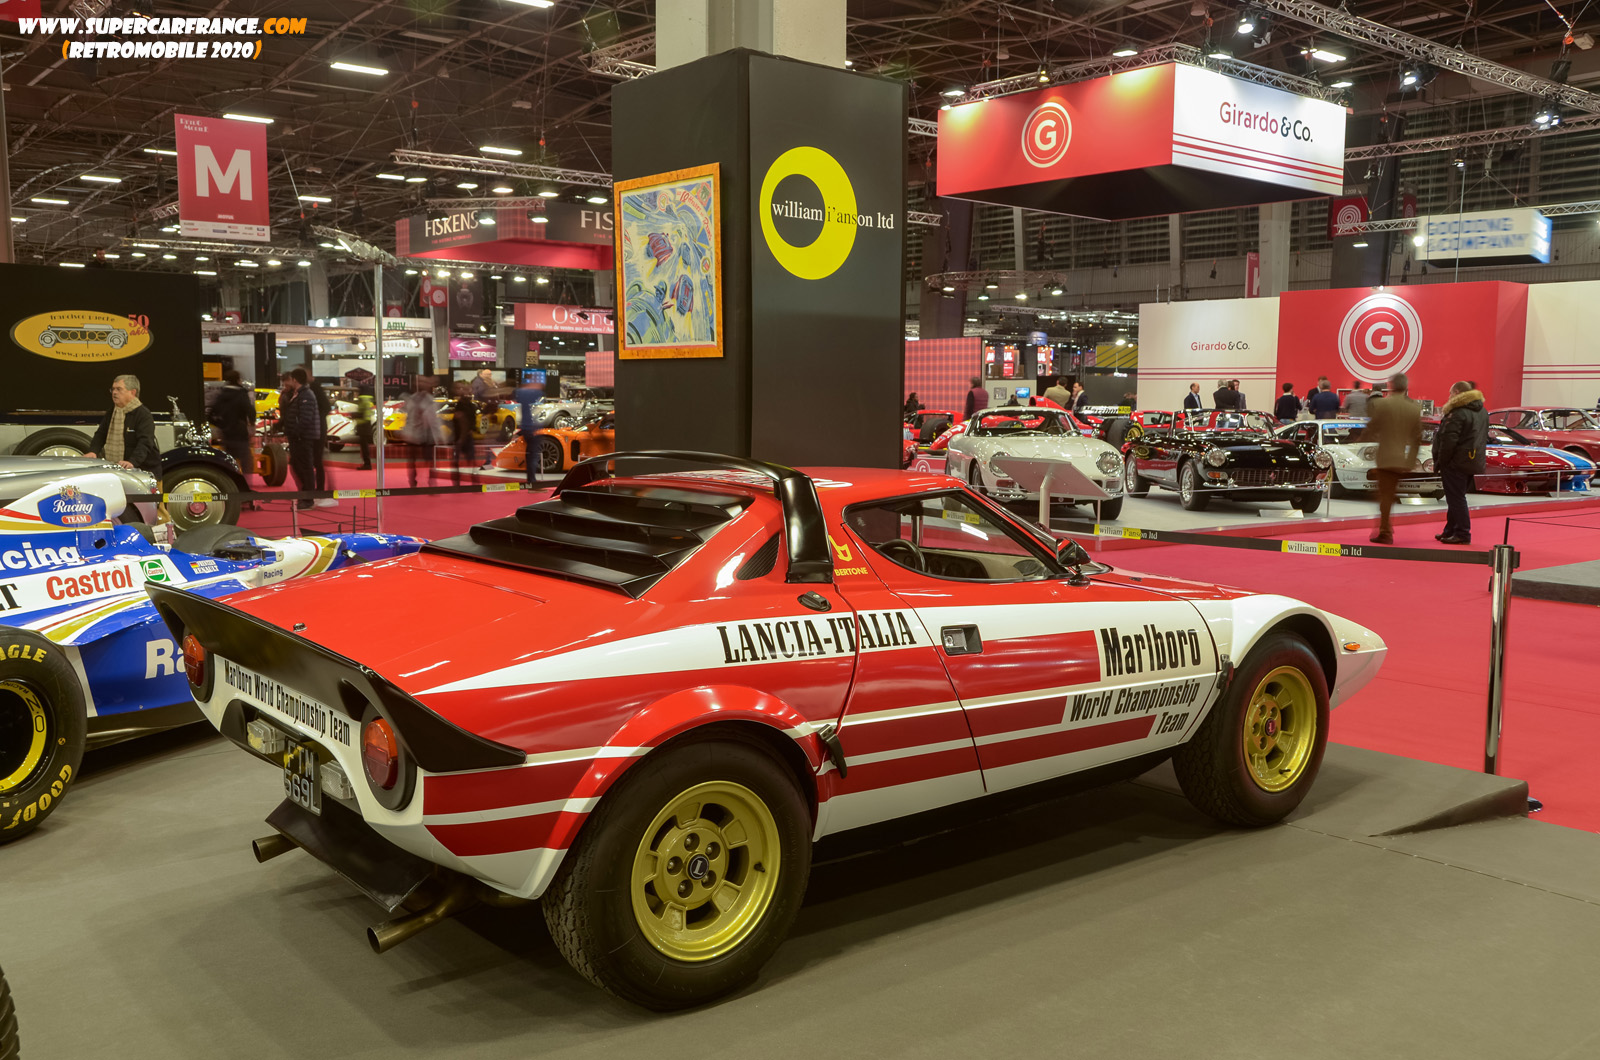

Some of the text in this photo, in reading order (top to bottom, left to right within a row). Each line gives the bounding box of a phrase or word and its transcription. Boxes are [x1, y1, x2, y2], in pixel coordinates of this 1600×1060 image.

[1219, 101, 1279, 134] Girardo
[1034, 118, 1057, 152] G
[194, 144, 253, 201] M
[424, 210, 479, 238] FISKENS
[771, 200, 824, 222] william
[876, 211, 895, 230] ltd
[1190, 341, 1228, 351] Girardo
[1364, 321, 1395, 357] G
[52, 499, 94, 515] Racing
[168, 493, 194, 501] william
[219, 493, 229, 501] ltd
[65, 515, 88, 524] TEAM
[1099, 526, 1123, 536] william
[1148, 530, 1158, 540] ltd
[1287, 542, 1318, 553] william
[1350, 546, 1362, 557] ltd
[45, 564, 134, 601] Castrol
[263, 568, 284, 580] Racing
[833, 566, 869, 577] BERTONE
[716, 610, 918, 665] LANCIA-ITALIA
[1099, 623, 1202, 677] Marlboro
[224, 659, 351, 748] Marlboro World Championship Team
[1069, 678, 1201, 723] World Championship
[1154, 710, 1190, 736] Team
[284, 767, 321, 815] 569L
